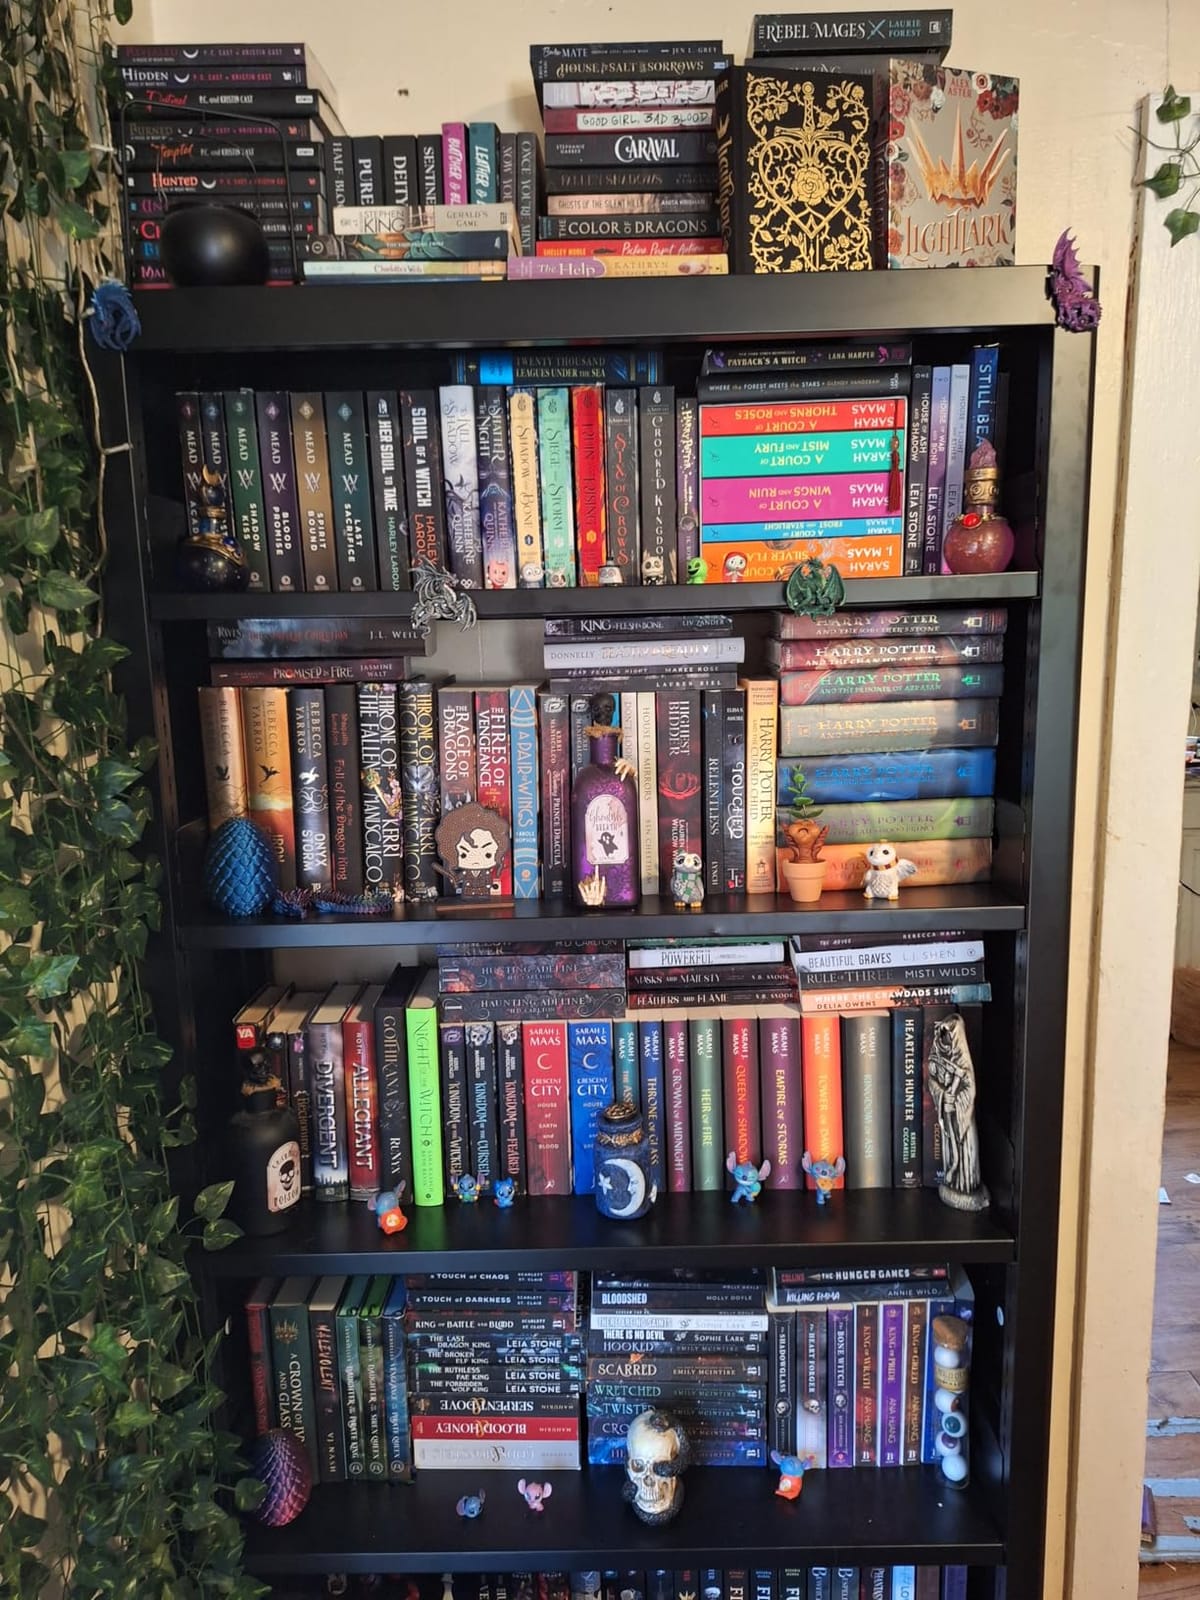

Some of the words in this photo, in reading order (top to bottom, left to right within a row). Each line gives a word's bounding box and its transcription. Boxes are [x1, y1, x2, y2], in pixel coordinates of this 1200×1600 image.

[758, 25, 766, 39] THE
[766, 24, 809, 42] REBEL
[811, 22, 866, 38] MAGES
[888, 20, 922, 28] LAURIE
[888, 29, 922, 38] FOREST
[562, 48, 588, 57] MATE
[122, 68, 169, 81] HIDDEN
[951, 78, 969, 88] ALEX
[948, 87, 972, 98] ASTER
[583, 114, 608, 126] GOOD
[611, 115, 640, 126] GIRL,
[672, 112, 709, 124] BLOOD
[521, 141, 531, 175] ONCE
[614, 136, 680, 162] CARAVAL
[152, 172, 198, 185] HUNTED
[358, 158, 374, 206] PURE
[393, 156, 409, 206] DEITY
[364, 210, 405, 218] STEPHEN
[364, 218, 406, 232] KING
[446, 212, 488, 220] GERALD'S
[558, 220, 566, 236] THE
[568, 222, 620, 235] COLOR
[624, 222, 632, 234] OF
[634, 220, 708, 235] DRAGONS
[520, 220, 530, 248] MINE
[906, 208, 1010, 260] LIGHTLARK
[544, 248, 567, 256] SHELLEY
[568, 248, 586, 256] NOBLE
[538, 264, 558, 274] The
[559, 264, 596, 276] Help
[828, 352, 844, 360] LANA
[845, 350, 876, 360] HARPER
[978, 363, 992, 408] STILL
[852, 403, 887, 414] MAAS
[854, 416, 895, 427] SARAH
[236, 427, 248, 462] MEAD
[378, 420, 394, 442] HER
[479, 415, 492, 458] NIGHT
[491, 406, 506, 464] SHATTER
[850, 438, 886, 449] MAAS
[186, 430, 198, 464] MEAD
[210, 431, 222, 465] MEAD
[270, 431, 281, 464] MEAD
[304, 431, 316, 464] MEAD
[342, 432, 354, 466] MEAD
[380, 444, 396, 474] SOUL
[852, 452, 892, 462] SARAH
[384, 476, 393, 486] TO
[849, 484, 884, 494] MAAS
[909, 483, 920, 508] LEIA
[384, 486, 398, 512] TAKE
[928, 486, 938, 512] LEIA
[242, 515, 250, 541] KISS
[249, 503, 261, 552] SHADOW
[272, 506, 284, 556] PROMISE
[282, 512, 292, 550] BLOOD
[306, 510, 318, 552] BOUND
[316, 512, 326, 550] SPIRIT
[344, 504, 356, 563] SACRIFICE
[354, 519, 363, 548] LAST
[426, 515, 438, 564] HARLEY
[454, 514, 464, 554] QUINN
[462, 501, 475, 564] KATHERINE
[907, 511, 919, 548] STONE
[926, 514, 937, 552] STONE
[849, 561, 890, 572] SARAH
[816, 616, 872, 628] HARRY
[880, 614, 939, 625] POTTER
[550, 650, 595, 660] DONNELLY
[816, 646, 874, 658] HARRY
[879, 644, 938, 656] POTTER
[820, 674, 878, 686] HARRY
[882, 672, 942, 684] POTTER
[359, 692, 378, 718] THE
[378, 694, 396, 744] THRONE
[252, 704, 263, 752] YARROS
[266, 700, 278, 758] REBECCA
[296, 706, 307, 754] YARROS
[310, 701, 322, 759] REBECCA
[402, 694, 419, 768] SECRETS
[668, 700, 680, 756] BIDDER
[679, 700, 690, 756] HIGHEST
[816, 720, 876, 732] HARRY
[880, 716, 938, 728] POTTER
[360, 723, 381, 770] FALLEN
[442, 708, 458, 782] DRAGONS
[478, 710, 492, 788] VENGEANCE
[758, 718, 774, 765] HARRY
[381, 748, 398, 770] OF
[708, 757, 720, 836] RELENTLESS
[727, 762, 745, 840] TOUCHED
[759, 770, 775, 823] POTTER
[302, 830, 314, 871] STORM
[314, 832, 328, 867] ONYX
[363, 792, 383, 882] MANISCALCO
[382, 818, 399, 858] KERRI
[404, 792, 420, 881] MANISCALCO
[420, 816, 434, 856] KERRI
[660, 950, 713, 964] POWERFUL
[808, 954, 855, 969] BEAUTIFUL
[858, 952, 892, 966] GRAVES
[904, 969, 934, 980] MISTI
[938, 968, 977, 978] WILDS
[480, 1000, 538, 1009] HAUNTING
[541, 997, 586, 1006] ADELINE
[817, 1002, 844, 1010] DELIA
[414, 1019, 430, 1067] NIGHT
[530, 1036, 561, 1046] MAAS
[576, 1036, 608, 1046] MAAS
[618, 1037, 626, 1060] MAAS
[904, 1019, 915, 1075] HEARTLESS
[382, 1016, 402, 1096] GOTHIKANA
[531, 1085, 562, 1096] CITY
[577, 1085, 608, 1096] CITY
[775, 1068, 787, 1106] EMPIRE
[904, 1078, 915, 1121] HUNTER
[316, 1062, 337, 1168] DIVERGENT
[352, 1062, 372, 1170] ALLEGIANT
[419, 1088, 434, 1136] WITCH
[776, 1110, 786, 1120] OF
[389, 1137, 402, 1174] RUNYX
[777, 1123, 788, 1166] STORMS
[902, 1127, 910, 1164] CICCARELLI
[602, 1293, 648, 1304] BLOODSHED
[506, 1340, 528, 1348] LEIA
[530, 1340, 562, 1348] STONE
[603, 1342, 655, 1352] HOOKED
[837, 1330, 846, 1356] BONE
[316, 1324, 335, 1393] MALEVOLENT
[504, 1356, 526, 1364] LEIA
[528, 1356, 560, 1365] STONE
[598, 1364, 658, 1377] SCARRED
[778, 1333, 788, 1393] SHADOWGLASS
[837, 1358, 847, 1387] WITCH
[278, 1370, 288, 1390] AND
[346, 1366, 356, 1406] DAUGHTER
[368, 1364, 378, 1404] DAUGHTER
[505, 1372, 526, 1380] LEIA
[528, 1372, 561, 1381] STONE
[506, 1386, 527, 1394] LEIA
[528, 1386, 562, 1394] STONE
[594, 1384, 662, 1398] WRETCHED
[278, 1392, 292, 1428] GLASS
[436, 1423, 480, 1434] HONEY
[486, 1423, 527, 1434] BLOOD
